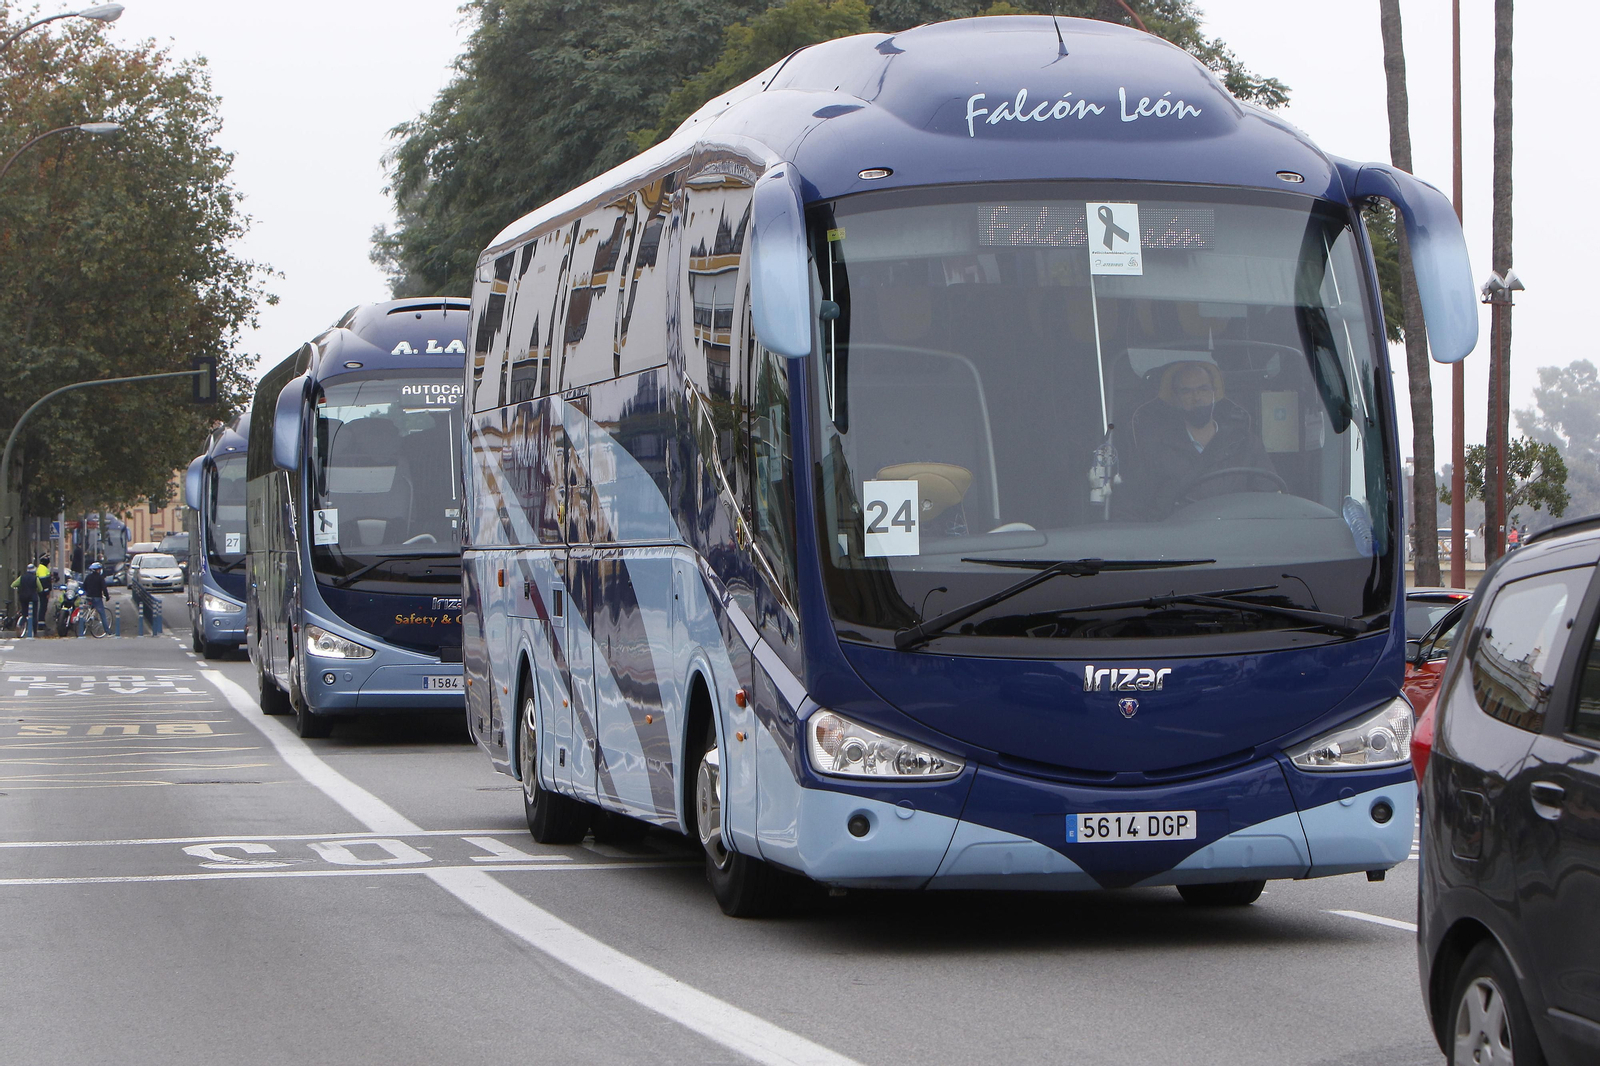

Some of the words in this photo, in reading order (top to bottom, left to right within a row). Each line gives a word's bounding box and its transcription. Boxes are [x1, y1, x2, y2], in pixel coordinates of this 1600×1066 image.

[965, 88, 1105, 137] Falcón
[1118, 87, 1202, 123] León
[986, 205, 1088, 247] Falcó
[1140, 216, 1205, 249] eón
[391, 341, 419, 355] A.
[425, 339, 466, 354] LA
[402, 385, 464, 395] AUTOCA
[425, 394, 463, 404] LAC
[866, 499, 916, 534] 24
[226, 538, 239, 548] 27
[395, 613, 437, 627] Safety
[441, 614, 452, 624] &
[432, 678, 458, 688] 1584
[1083, 665, 1172, 691] Irizar
[17, 723, 214, 736] BUS
[1083, 816, 1139, 838] 5614
[1148, 815, 1189, 837] DGP
